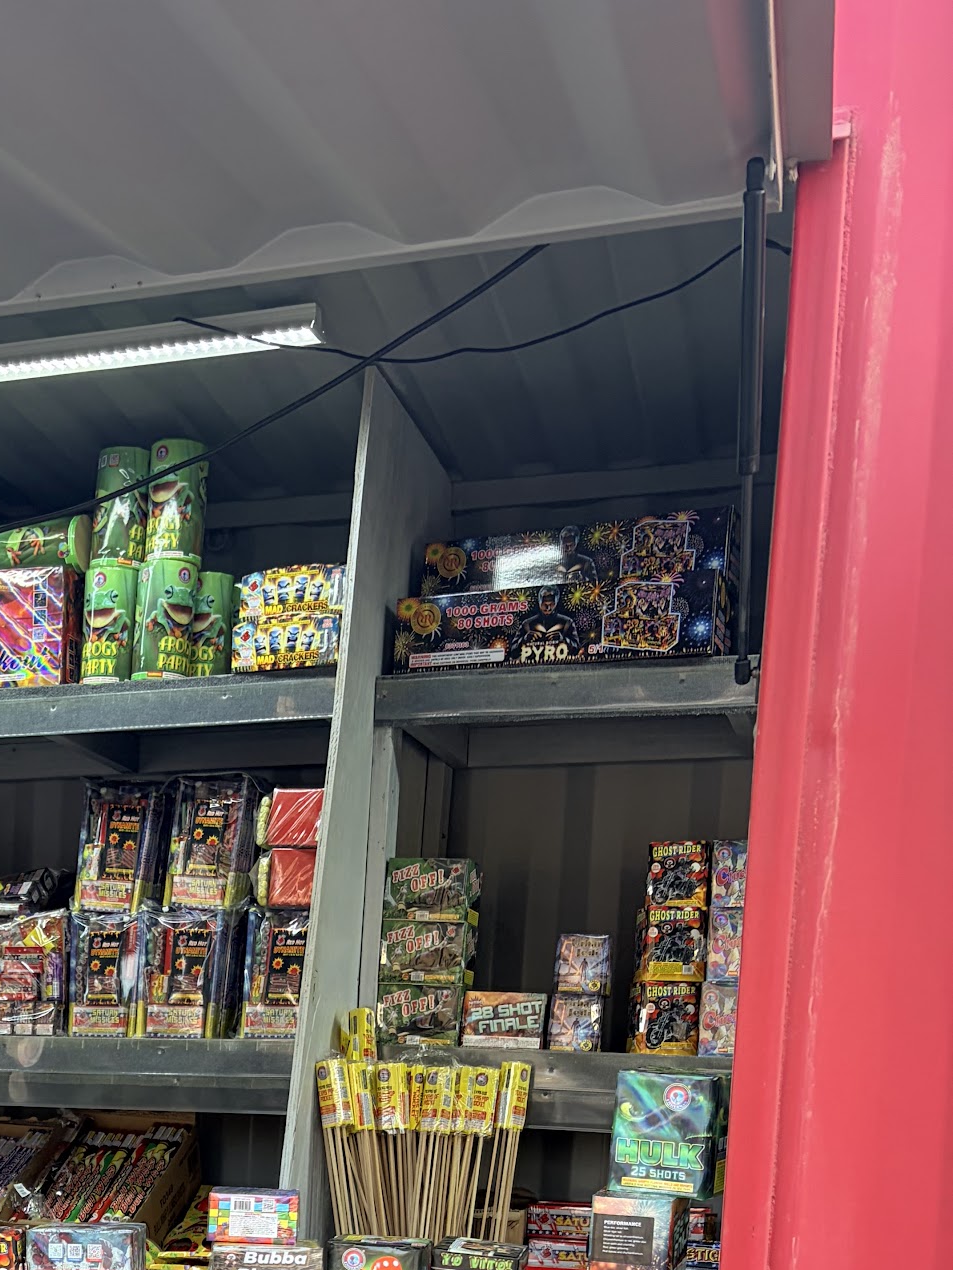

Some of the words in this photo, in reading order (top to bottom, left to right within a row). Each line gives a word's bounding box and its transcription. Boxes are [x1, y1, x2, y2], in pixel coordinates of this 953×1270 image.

[265, 605, 284, 615] MAD
[286, 601, 328, 613] CRACKERS
[446, 606, 479, 618] 1000
[481, 601, 528, 615] GRAMS
[457, 618, 472, 630] 80
[474, 614, 513, 629] SHOTS
[190, 645, 215, 661] OGS
[257, 655, 275, 665] MAD
[278, 650, 319, 663] CRACKERS
[521, 643, 568, 663] PYRO
[652, 845, 677, 858] GHOST
[678, 843, 701, 854] RIDER
[392, 863, 420, 883] FIZZ
[410, 869, 445, 892] OFF!
[649, 909, 675, 921] GHOST
[677, 910, 699, 919] RIDER
[386, 924, 415, 944] FIZZ
[406, 930, 440, 954] OFF!
[383, 989, 411, 1007] FIZZ
[646, 986, 671, 997] GHOST
[673, 986, 696, 996] RIDER
[402, 994, 435, 1017] OFF!
[471, 1006, 494, 1019] 28
[498, 1001, 542, 1018] SHOT
[478, 1015, 539, 1033] FINALE
[616, 1137, 704, 1170] HULK
[630, 1166, 646, 1177] 25
[650, 1169, 686, 1180] SHOTS
[555, 1216, 590, 1227] SATU
[243, 1251, 308, 1266] Bubba
[441, 1252, 463, 1267] YO
[558, 1250, 589, 1262] SATU
